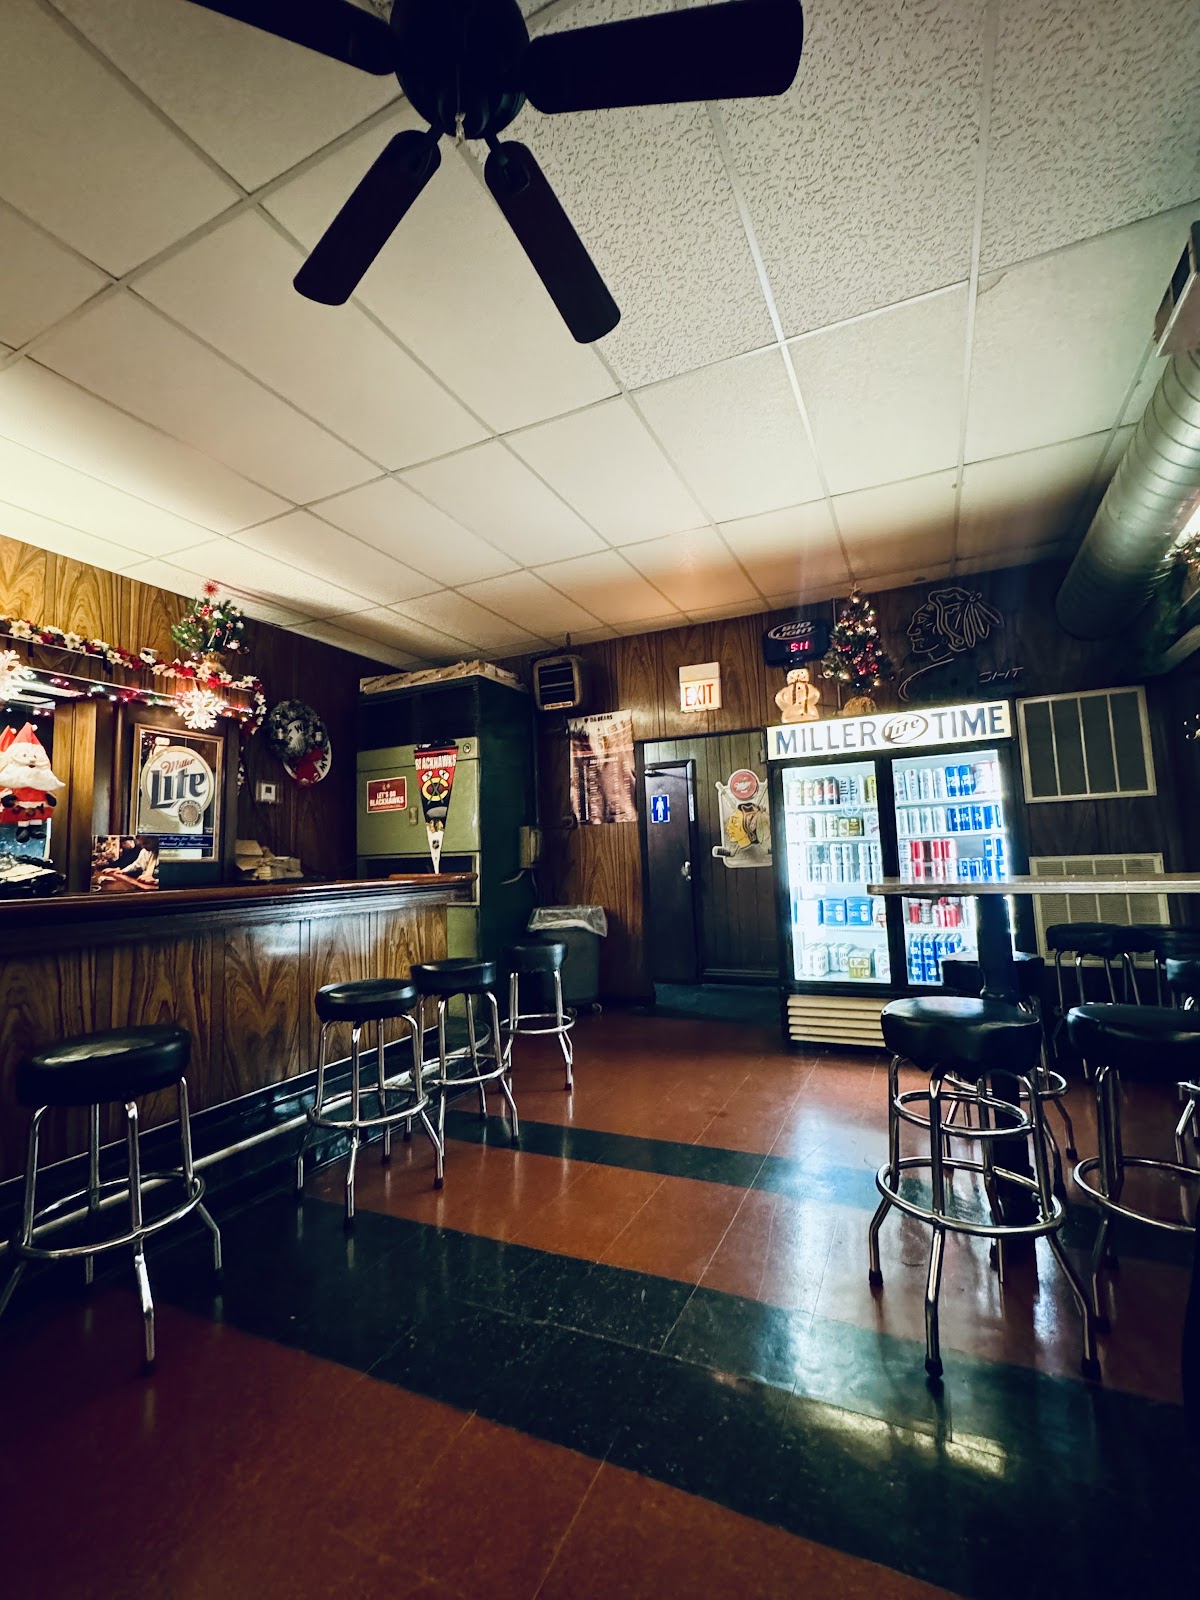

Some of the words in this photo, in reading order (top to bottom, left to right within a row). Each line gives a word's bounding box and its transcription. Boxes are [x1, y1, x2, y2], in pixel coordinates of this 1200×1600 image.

[775, 626, 815, 638] LIGHT
[782, 621, 811, 632] BUD
[790, 641, 809, 653] 5:11
[685, 683, 714, 707] EXIT
[776, 720, 877, 755] MILLER
[885, 719, 920, 743] Lite
[931, 705, 1005, 740] TIME
[161, 758, 195, 774] Miller
[415, 753, 457, 770] BLACKHAWKS
[150, 768, 206, 809] Lite
[369, 796, 404, 807] BLACKHAWKS
